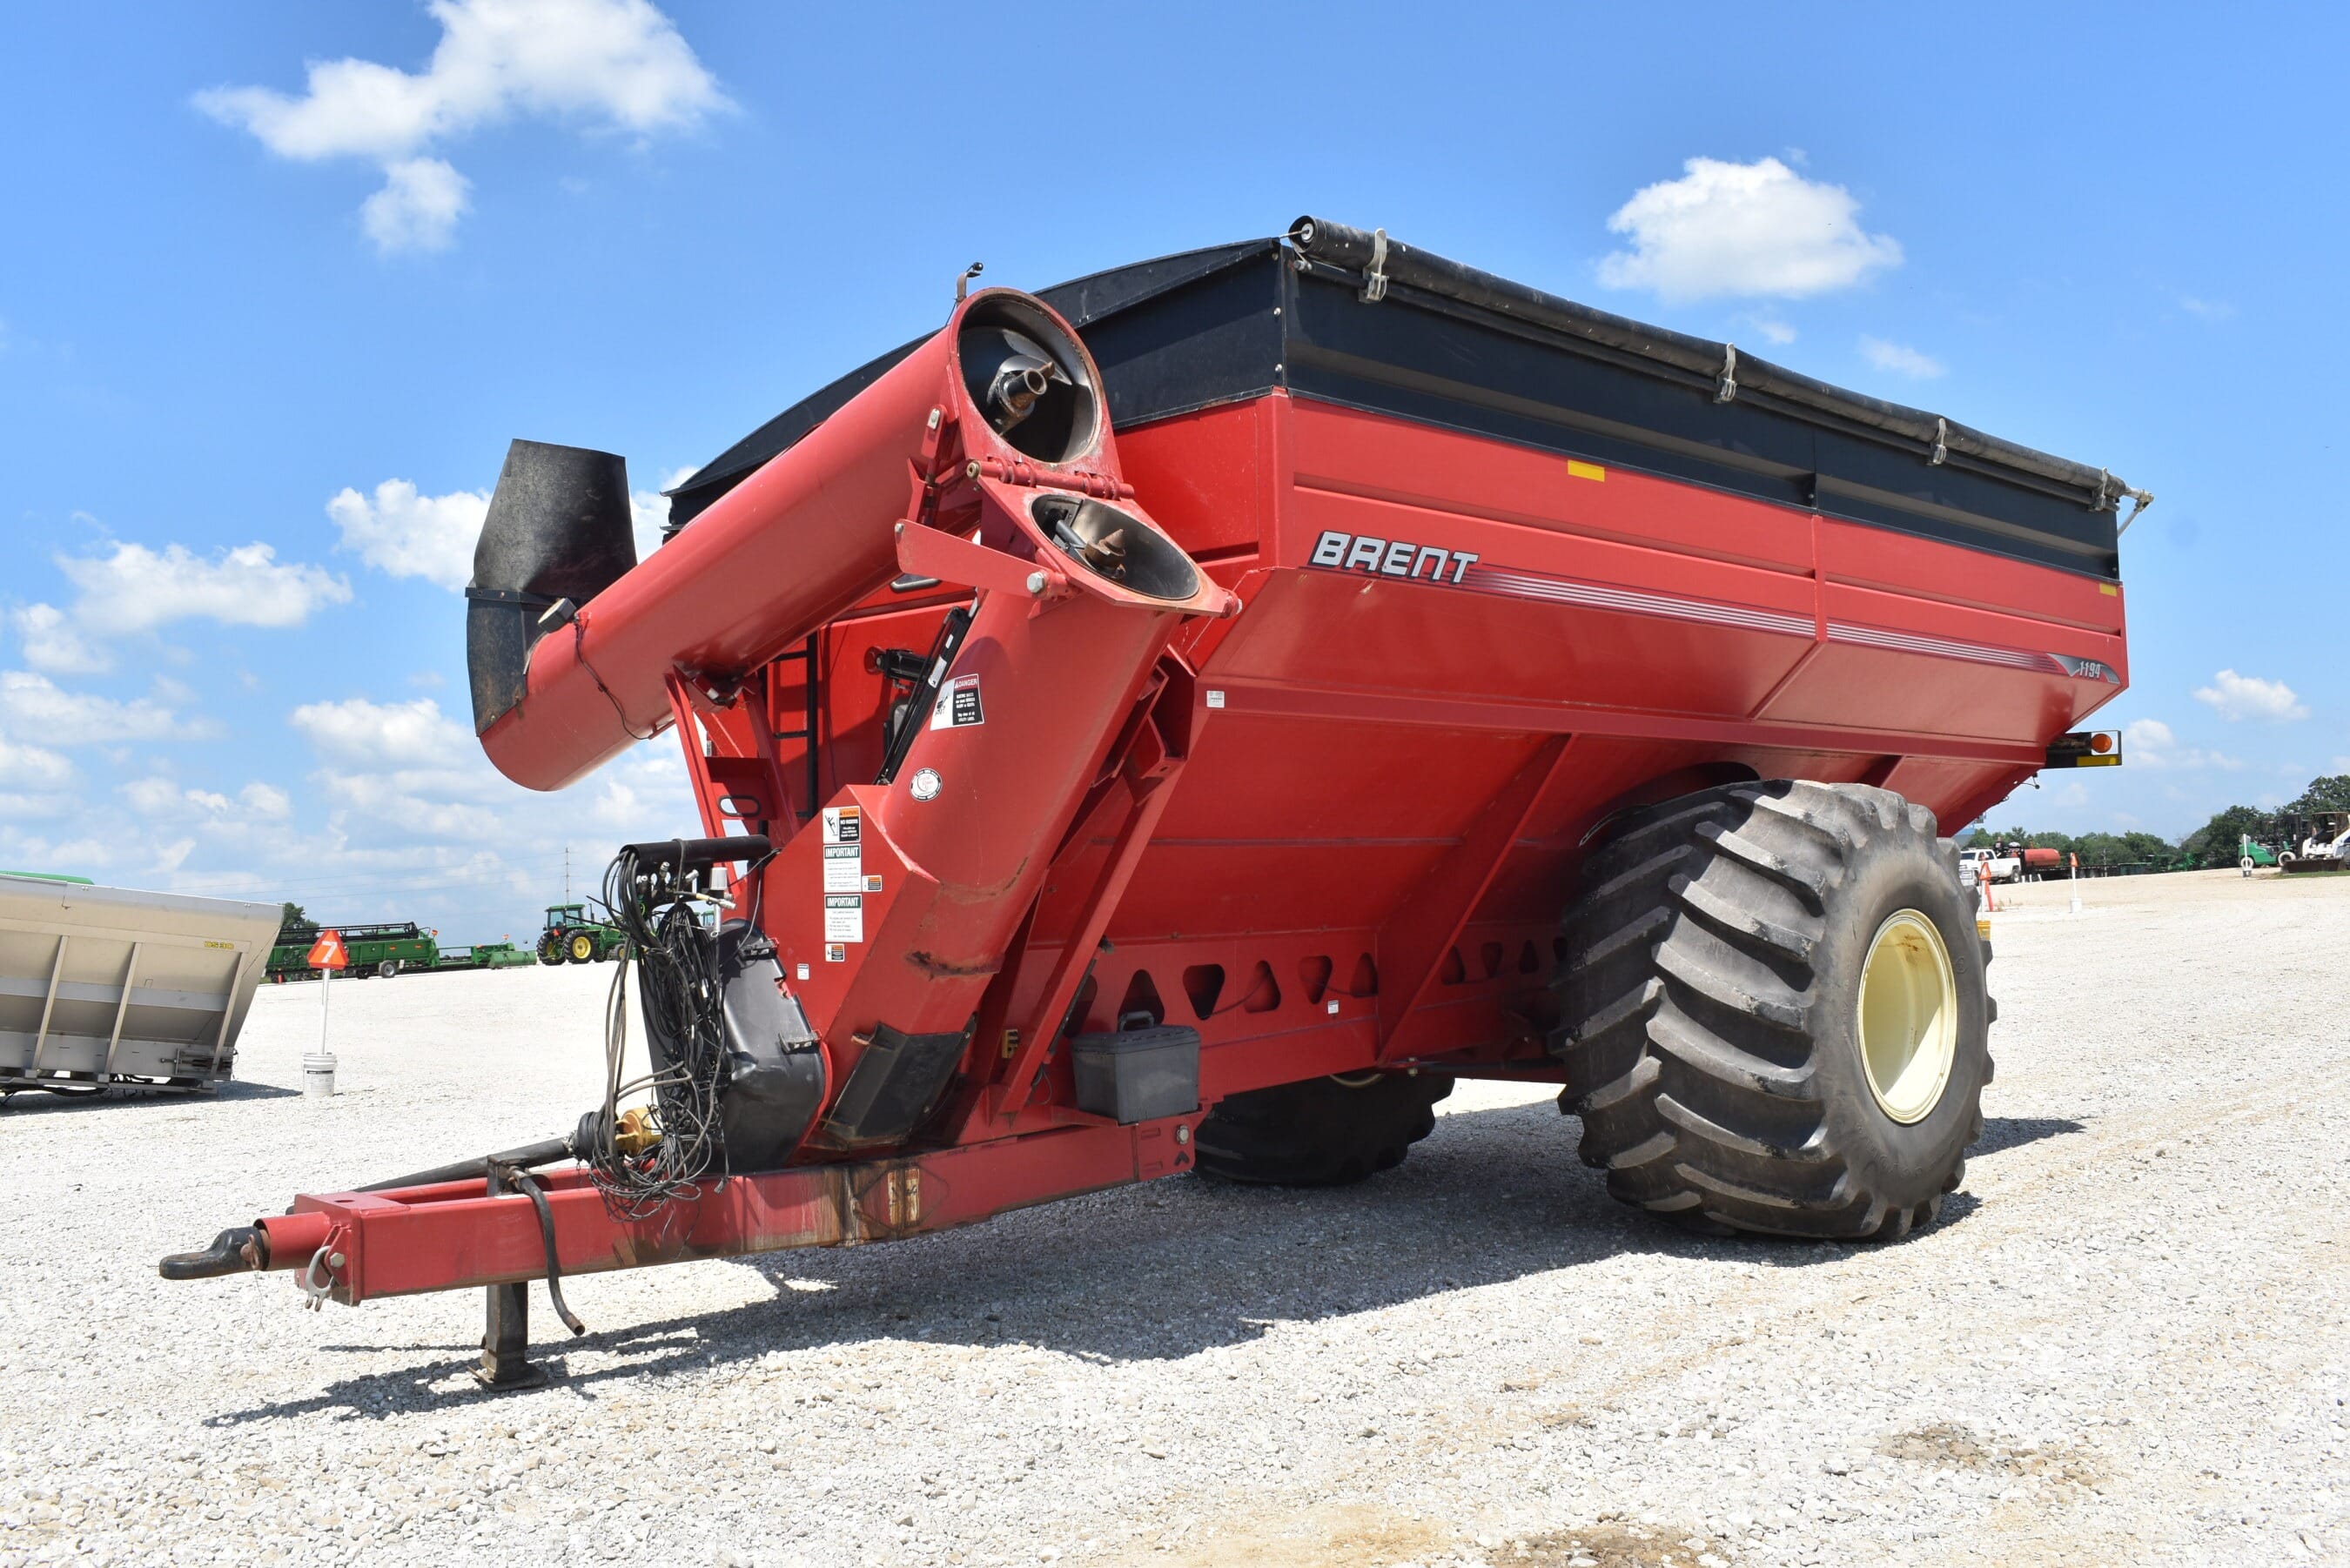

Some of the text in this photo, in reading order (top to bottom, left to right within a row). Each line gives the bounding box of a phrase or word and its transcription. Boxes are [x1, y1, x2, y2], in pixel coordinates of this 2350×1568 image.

[1307, 529, 1480, 585] BRENT
[2080, 661, 2100, 678] 1194
[958, 678, 977, 687] DANGER
[825, 847, 858, 857] IMPORTANT
[827, 897, 858, 907] IMPORTANT
[321, 941, 338, 963] 7
